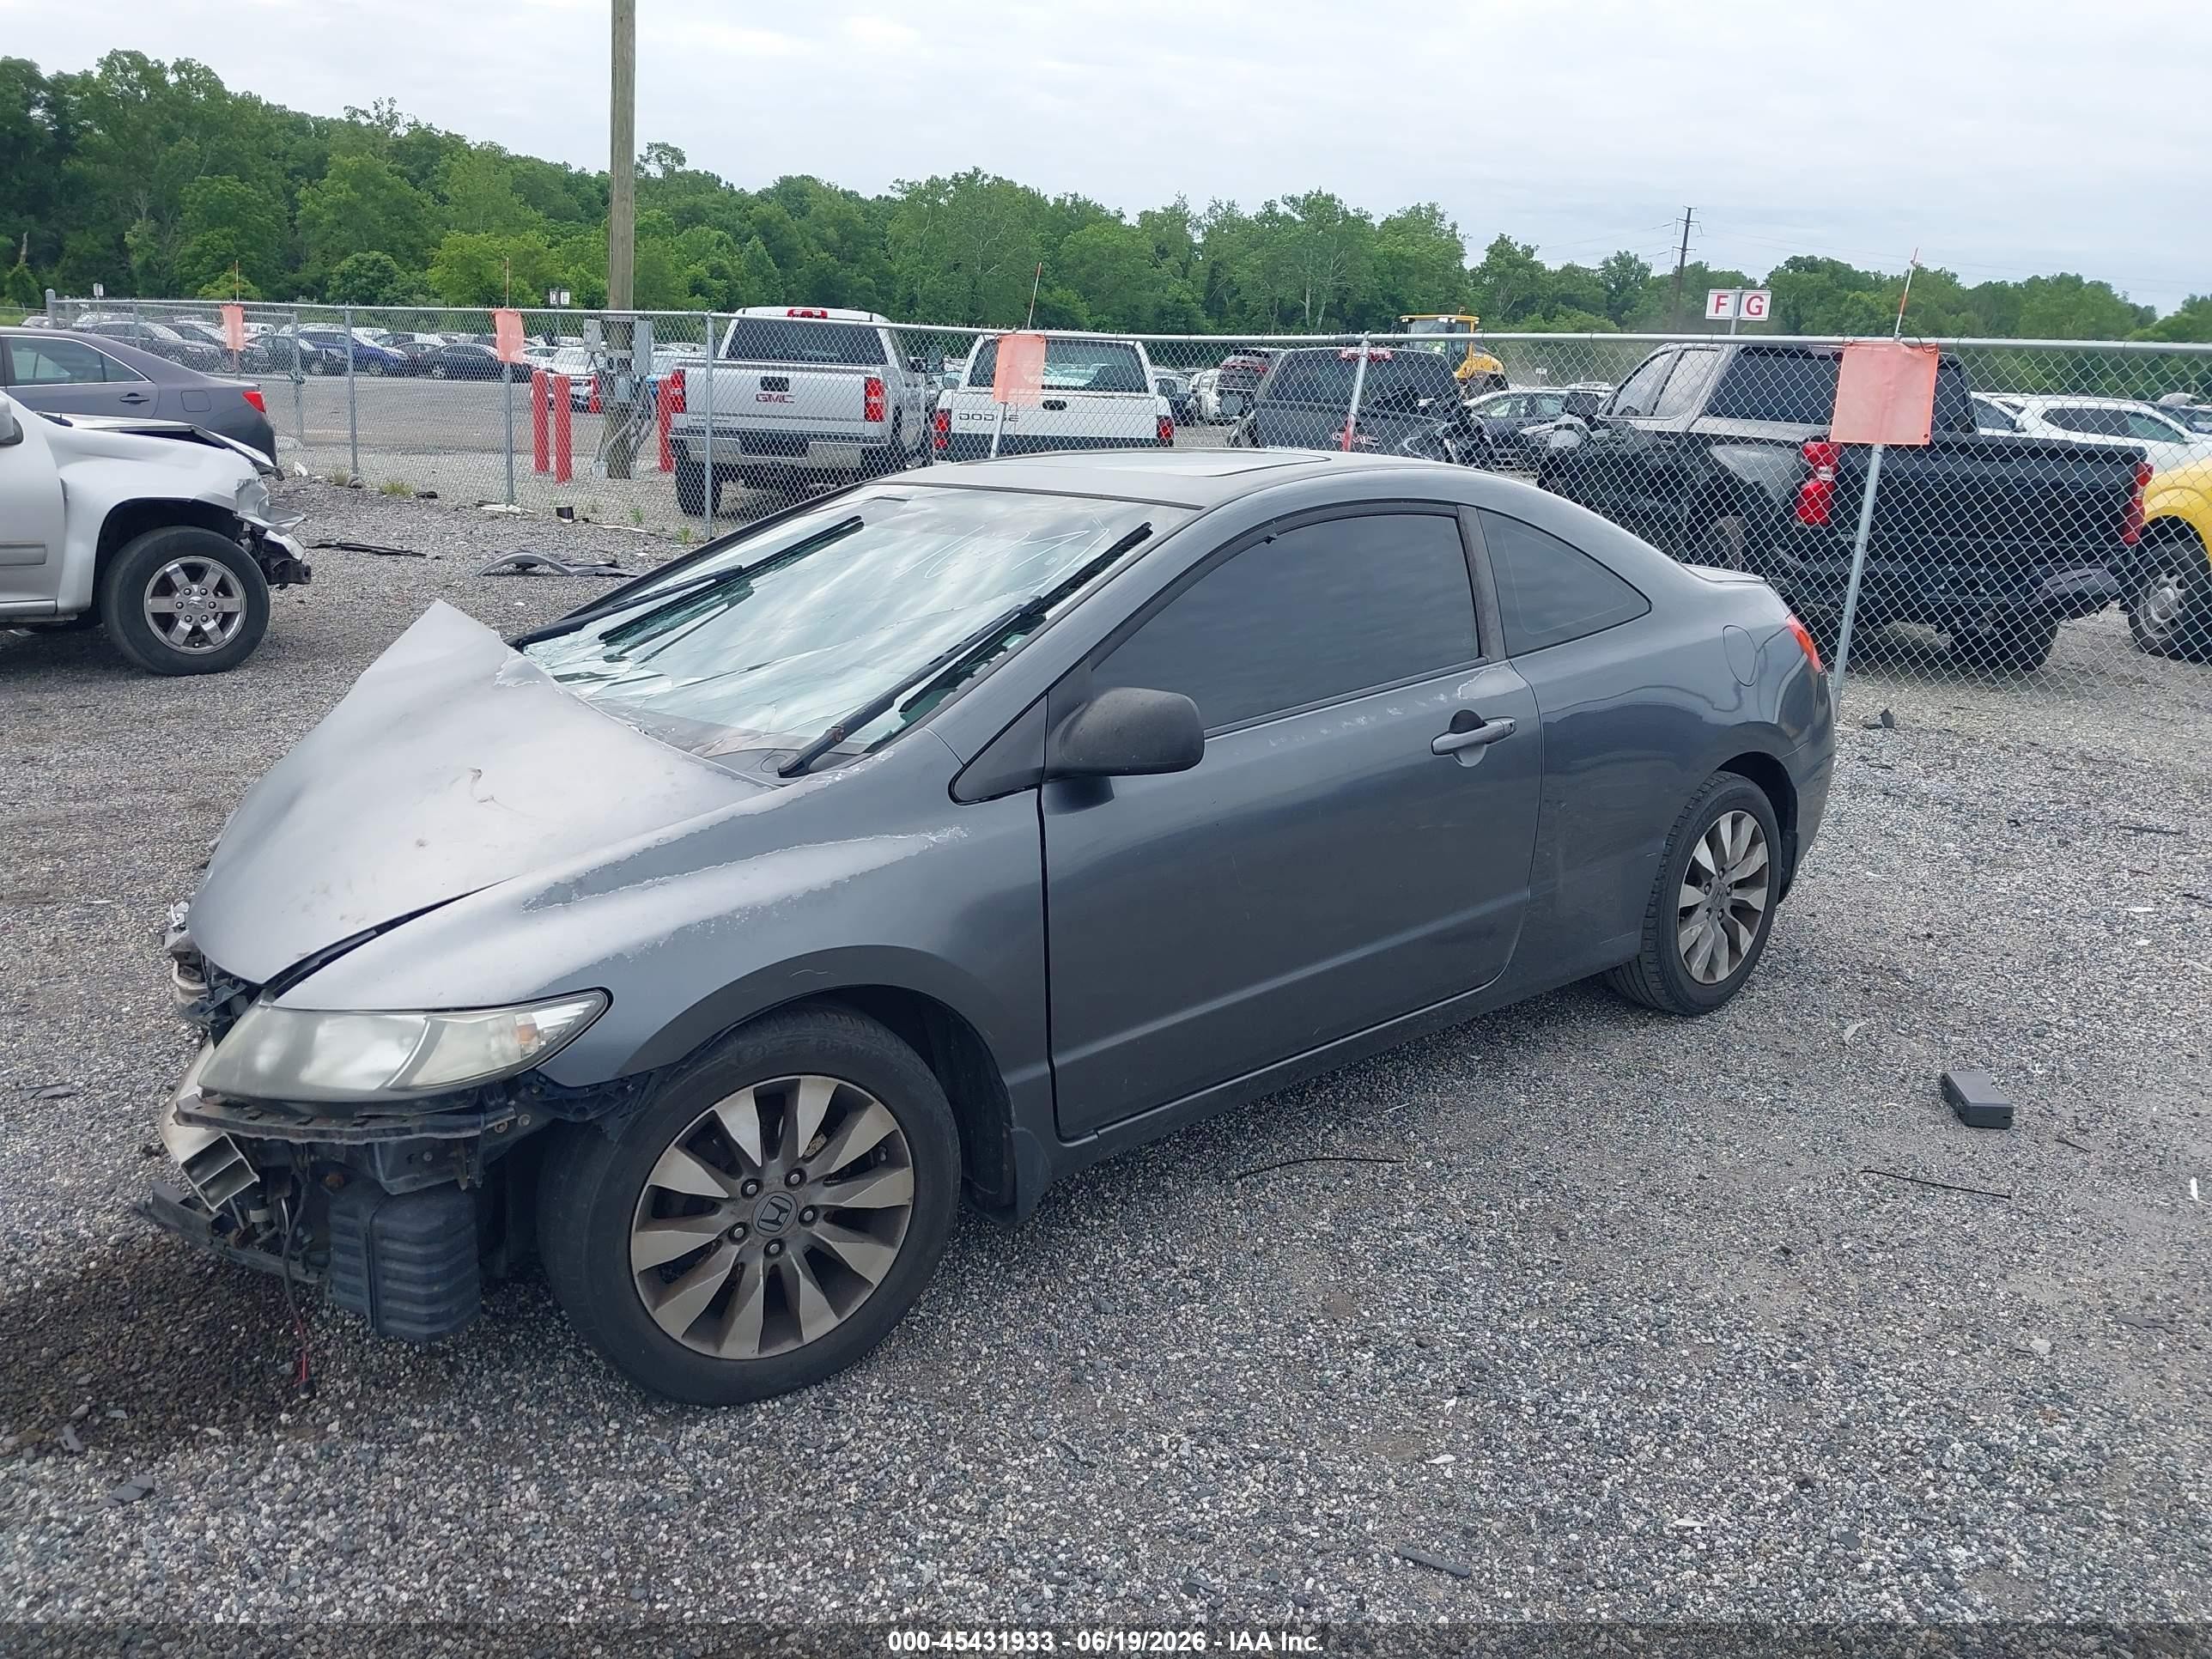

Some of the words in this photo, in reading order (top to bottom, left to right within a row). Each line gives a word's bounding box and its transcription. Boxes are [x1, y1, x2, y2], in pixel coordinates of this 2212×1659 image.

[1715, 295, 1729, 314] F
[1746, 295, 1765, 316] G
[756, 393, 795, 404] GMC
